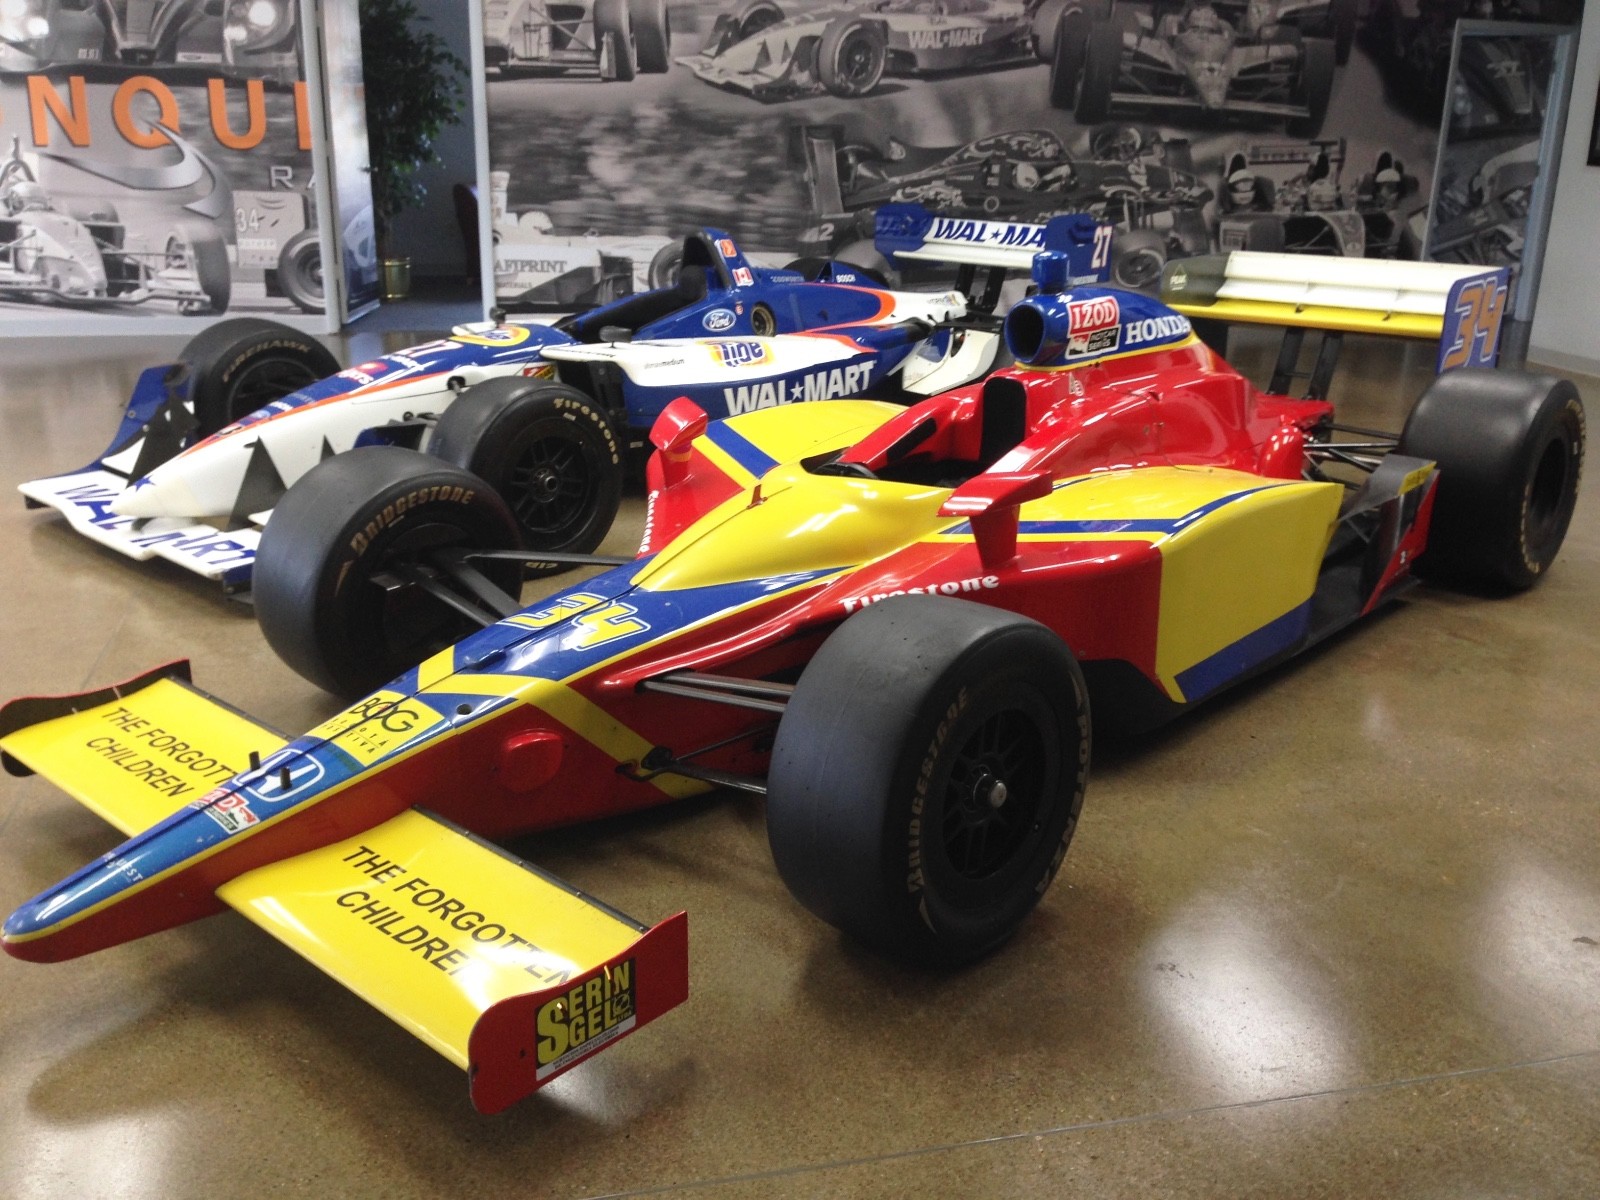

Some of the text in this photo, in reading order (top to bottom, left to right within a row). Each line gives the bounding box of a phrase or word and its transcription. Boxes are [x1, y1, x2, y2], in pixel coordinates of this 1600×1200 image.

[236, 208, 260, 232] 34
[1090, 225, 1113, 270] 27
[708, 311, 731, 330] Ford
[1072, 301, 1116, 330] IZOD
[1125, 315, 1191, 344] HONDA
[1439, 276, 1508, 372] 34
[553, 398, 619, 464] Firestone
[349, 485, 475, 557] BRIDGESTONE
[497, 592, 653, 652] 34
[88, 737, 195, 797] CHILDREN
[102, 707, 238, 785] THE FORGOTT
[342, 845, 407, 884] THE
[336, 891, 470, 976] CHILDRE
